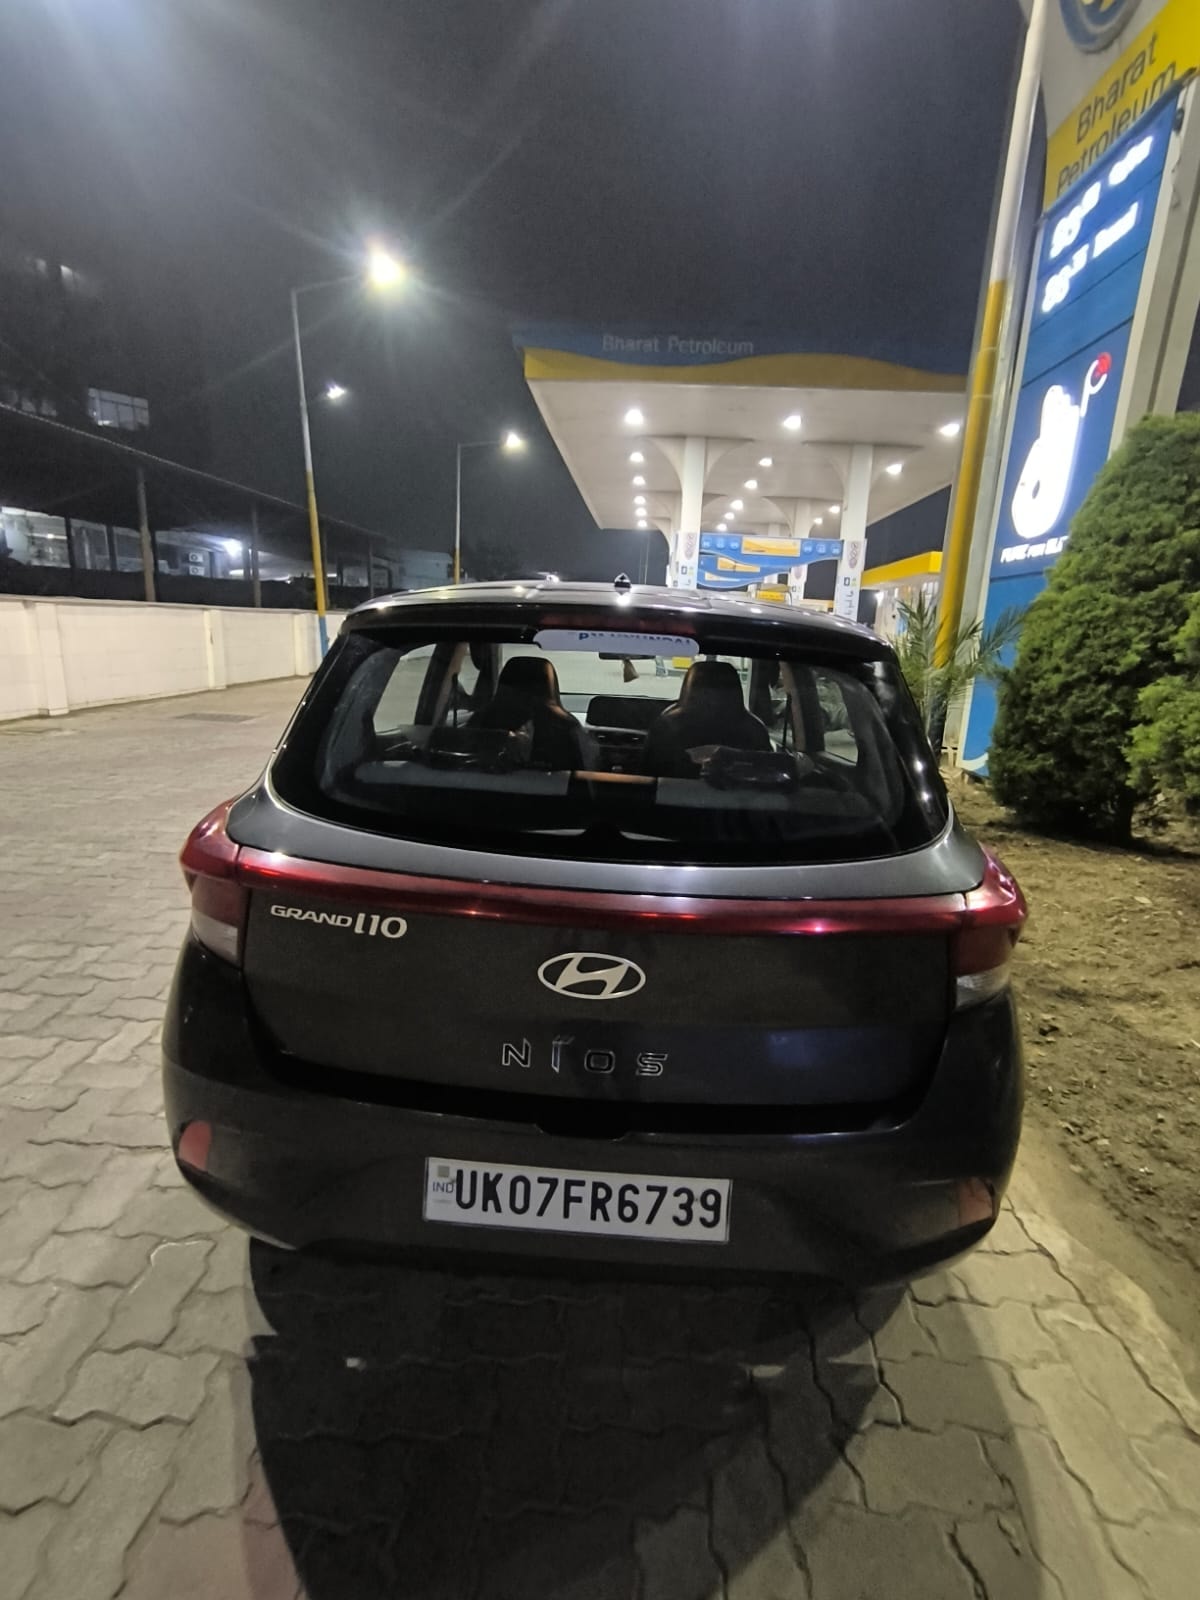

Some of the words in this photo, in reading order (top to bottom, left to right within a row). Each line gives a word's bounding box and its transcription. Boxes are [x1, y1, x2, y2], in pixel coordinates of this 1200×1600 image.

[1077, 33, 1158, 144] Bharat
[1057, 61, 1177, 193] Petroleum
[602, 335, 659, 353] Bharat
[667, 336, 754, 355] Petroleum
[270, 904, 353, 927] GRAND
[432, 1181, 454, 1193] IND
[455, 1168, 722, 1229] UK07FR6739
